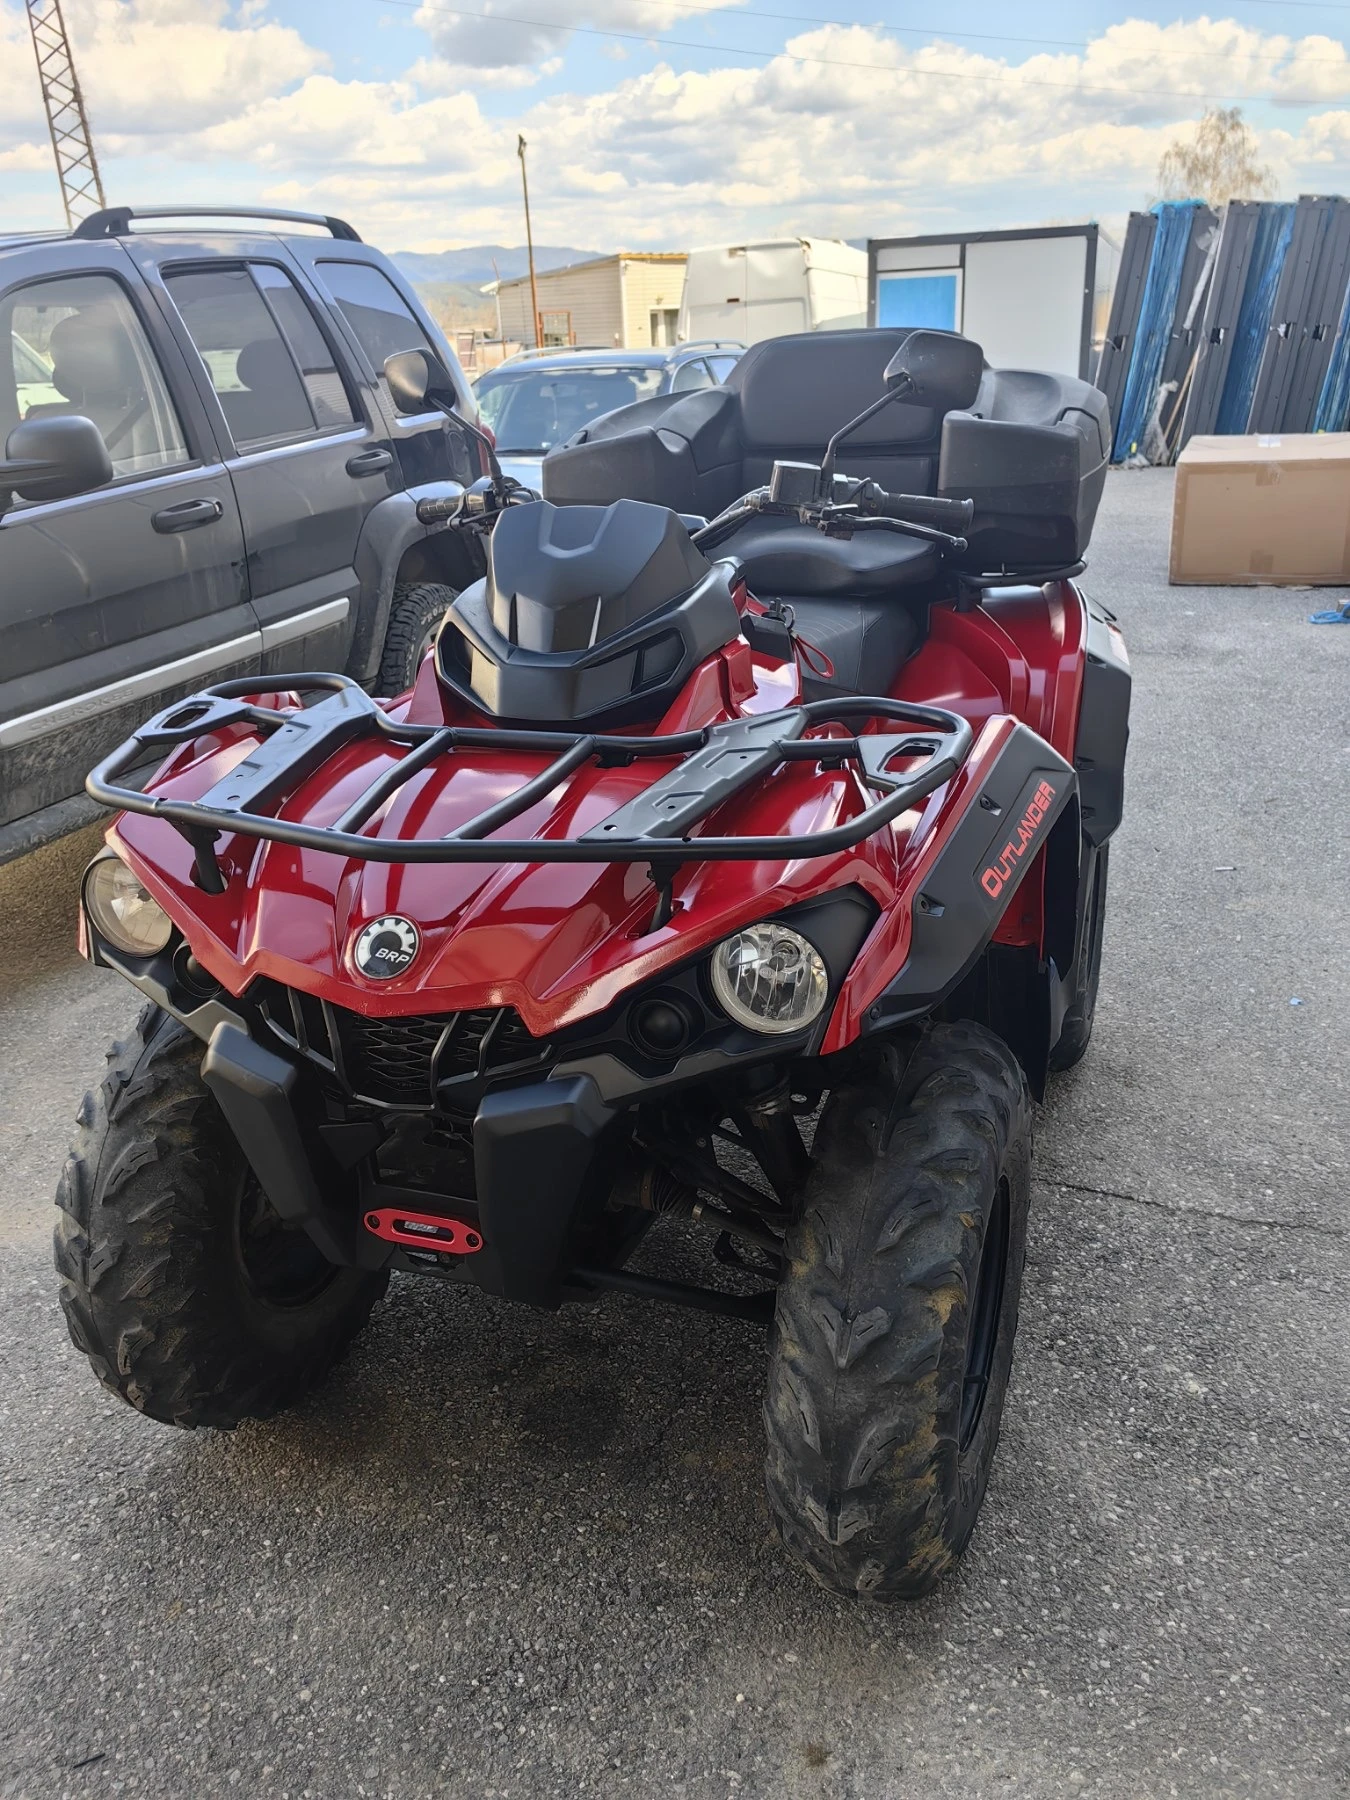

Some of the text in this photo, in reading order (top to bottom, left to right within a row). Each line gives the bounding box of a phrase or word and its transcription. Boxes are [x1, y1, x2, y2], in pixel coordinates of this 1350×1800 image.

[28, 688, 135, 732] CHEROKEE
[981, 780, 1056, 898] OUTLANDER
[375, 947, 410, 963] BRP
